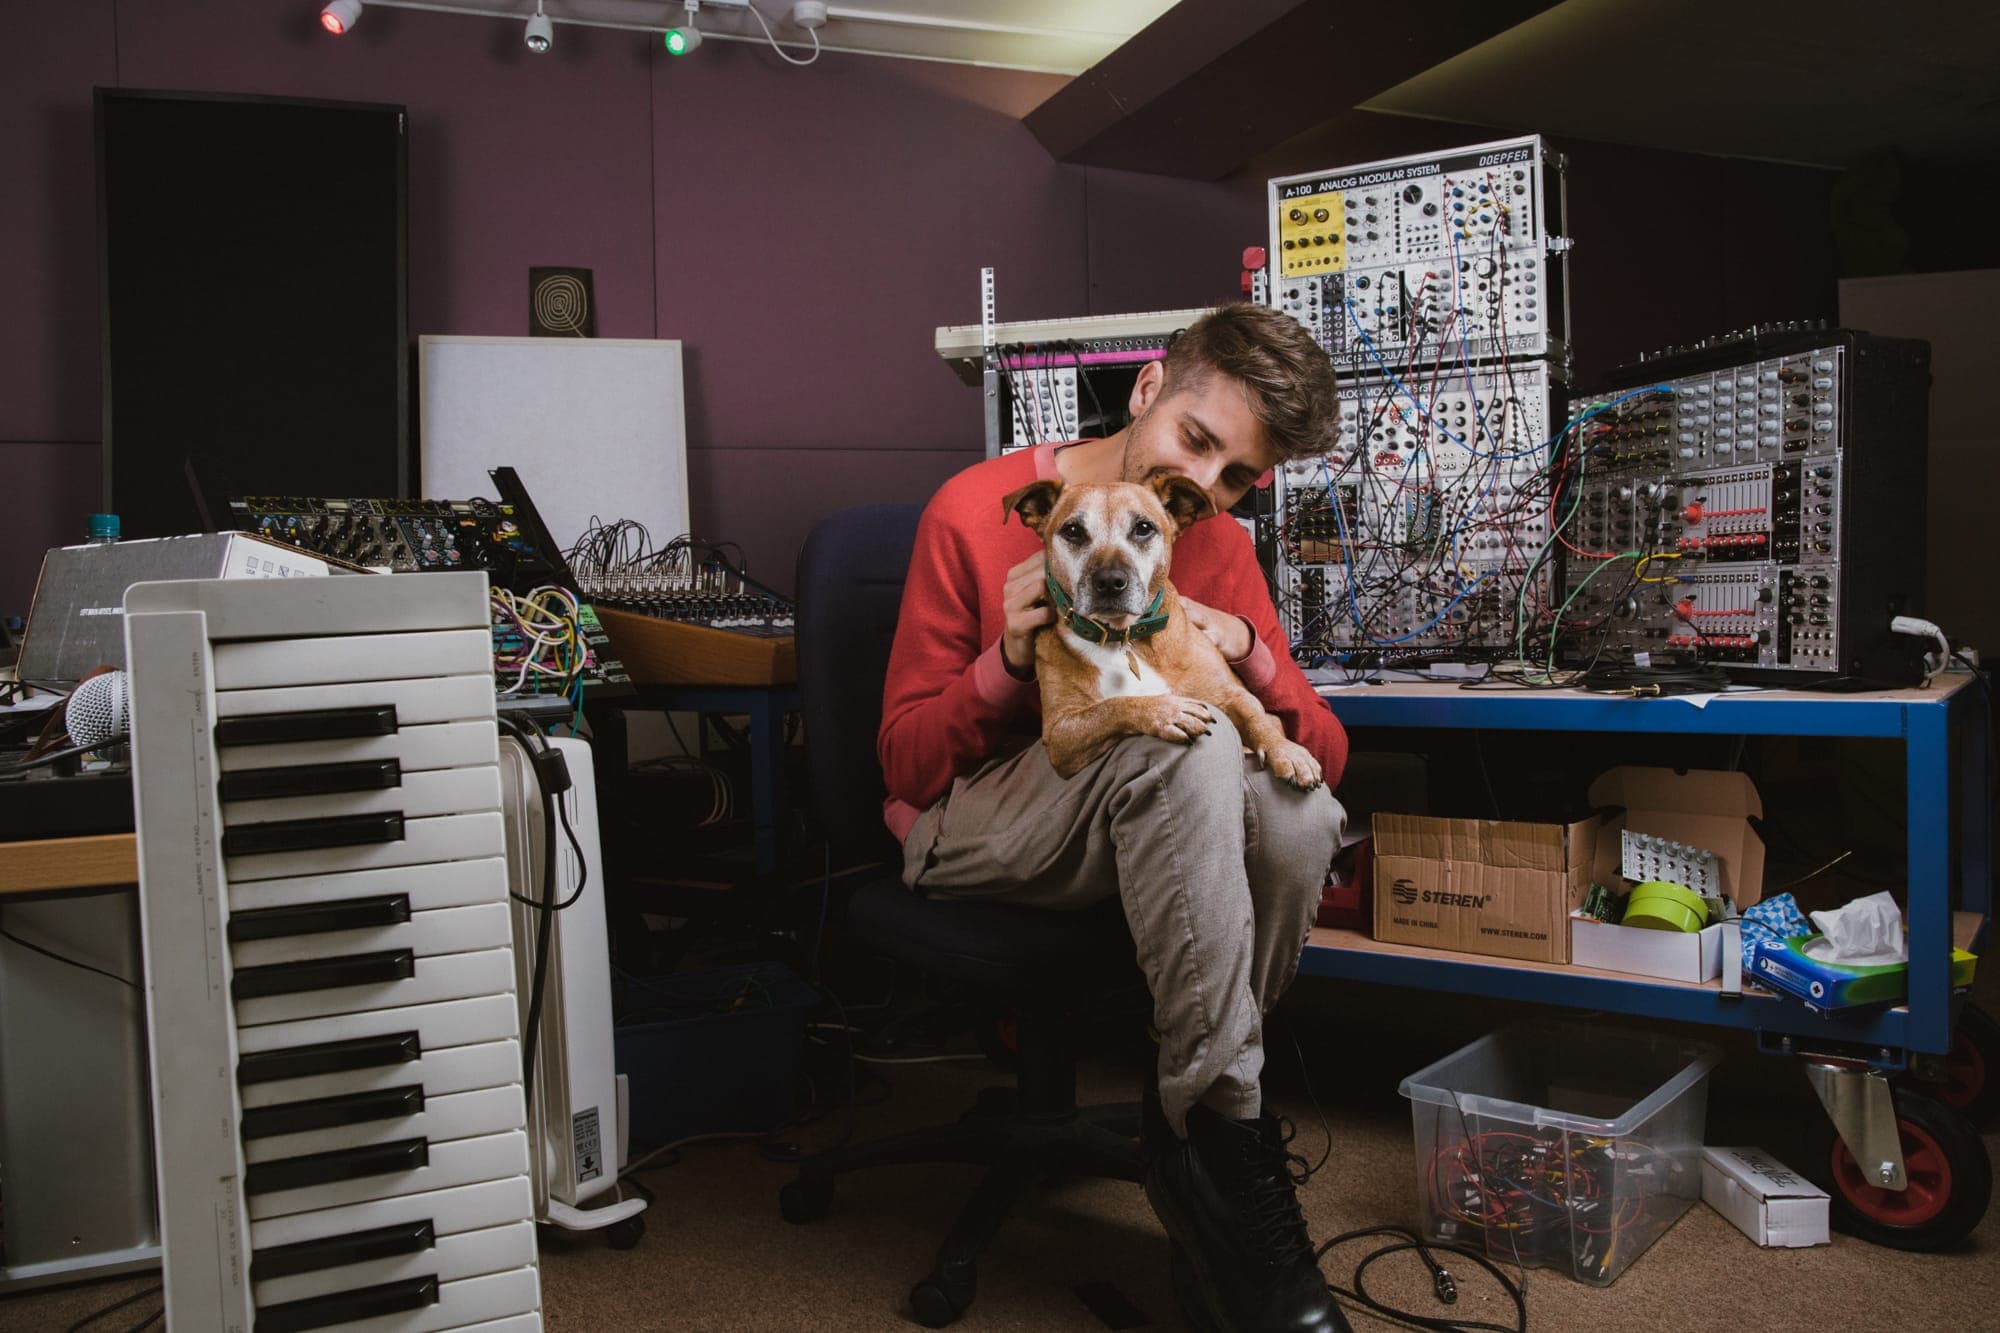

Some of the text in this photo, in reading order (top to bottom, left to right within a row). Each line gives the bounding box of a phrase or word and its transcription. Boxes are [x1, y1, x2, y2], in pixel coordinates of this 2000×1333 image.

[1479, 149, 1530, 167] DOEPFER
[1286, 184, 1312, 198] A-100
[1318, 176, 1358, 192] ANALOG
[1359, 169, 1405, 186] MODULAR
[1406, 164, 1441, 178] SYSTEM
[1480, 927, 1548, 941] WWW.STEREN.COM
